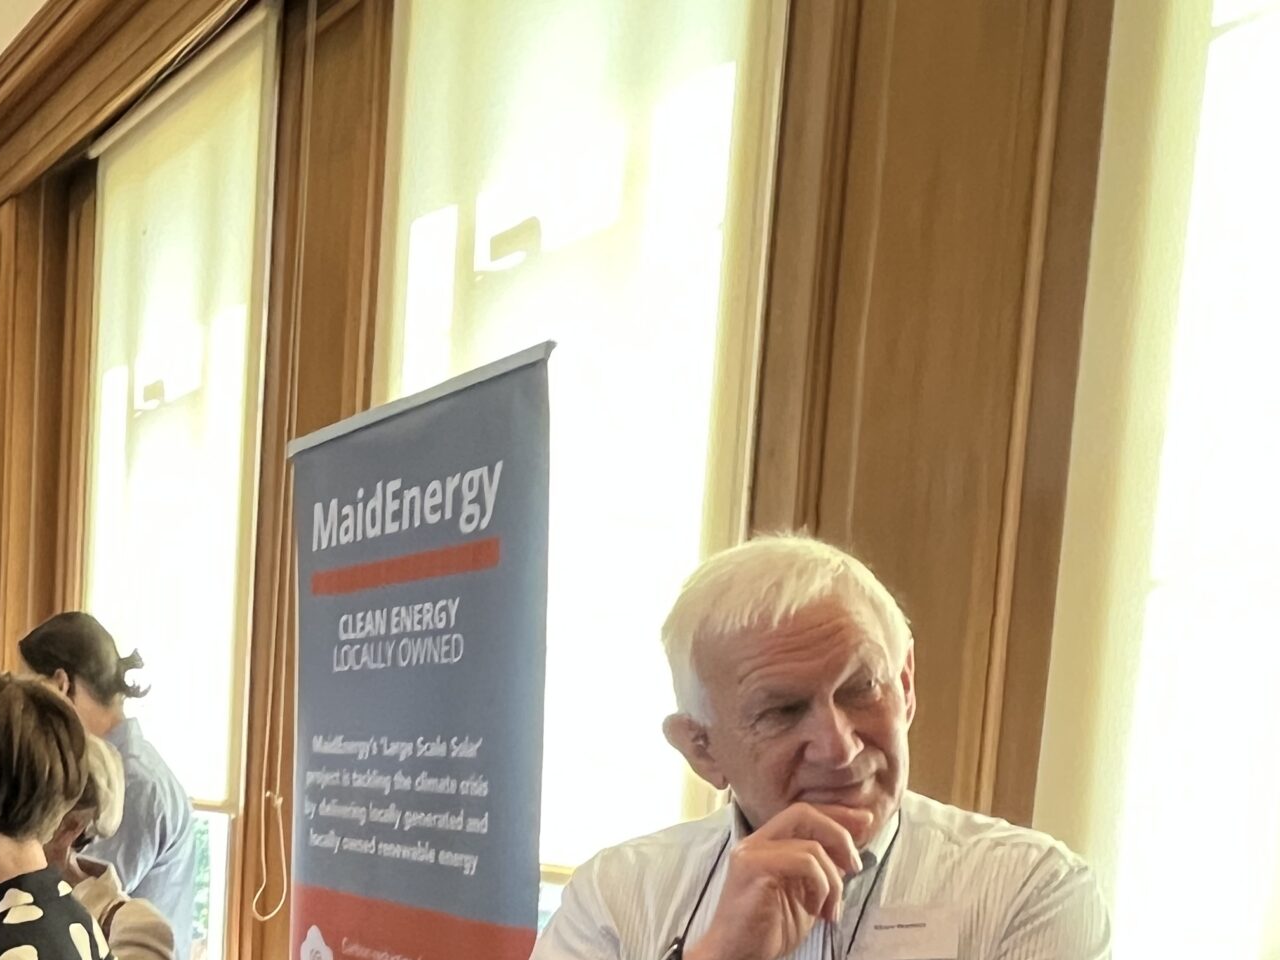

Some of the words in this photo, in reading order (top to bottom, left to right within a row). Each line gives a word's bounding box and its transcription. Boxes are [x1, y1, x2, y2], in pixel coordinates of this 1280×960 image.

[312, 461, 503, 552] MaidEnergy
[339, 606, 387, 640] CLEAN
[390, 597, 460, 635] ENERGY
[333, 639, 395, 673] LOCALLY
[399, 633, 464, 668] OWNED
[305, 767, 340, 790] project
[342, 769, 351, 786] is
[393, 770, 412, 790] the
[415, 771, 457, 794] climate
[460, 775, 488, 797] crisis
[369, 802, 403, 830] locally
[404, 808, 464, 831] generated
[466, 812, 488, 834] and
[309, 828, 342, 854] locally
[378, 841, 436, 863] renewable
[438, 851, 478, 875] energy
